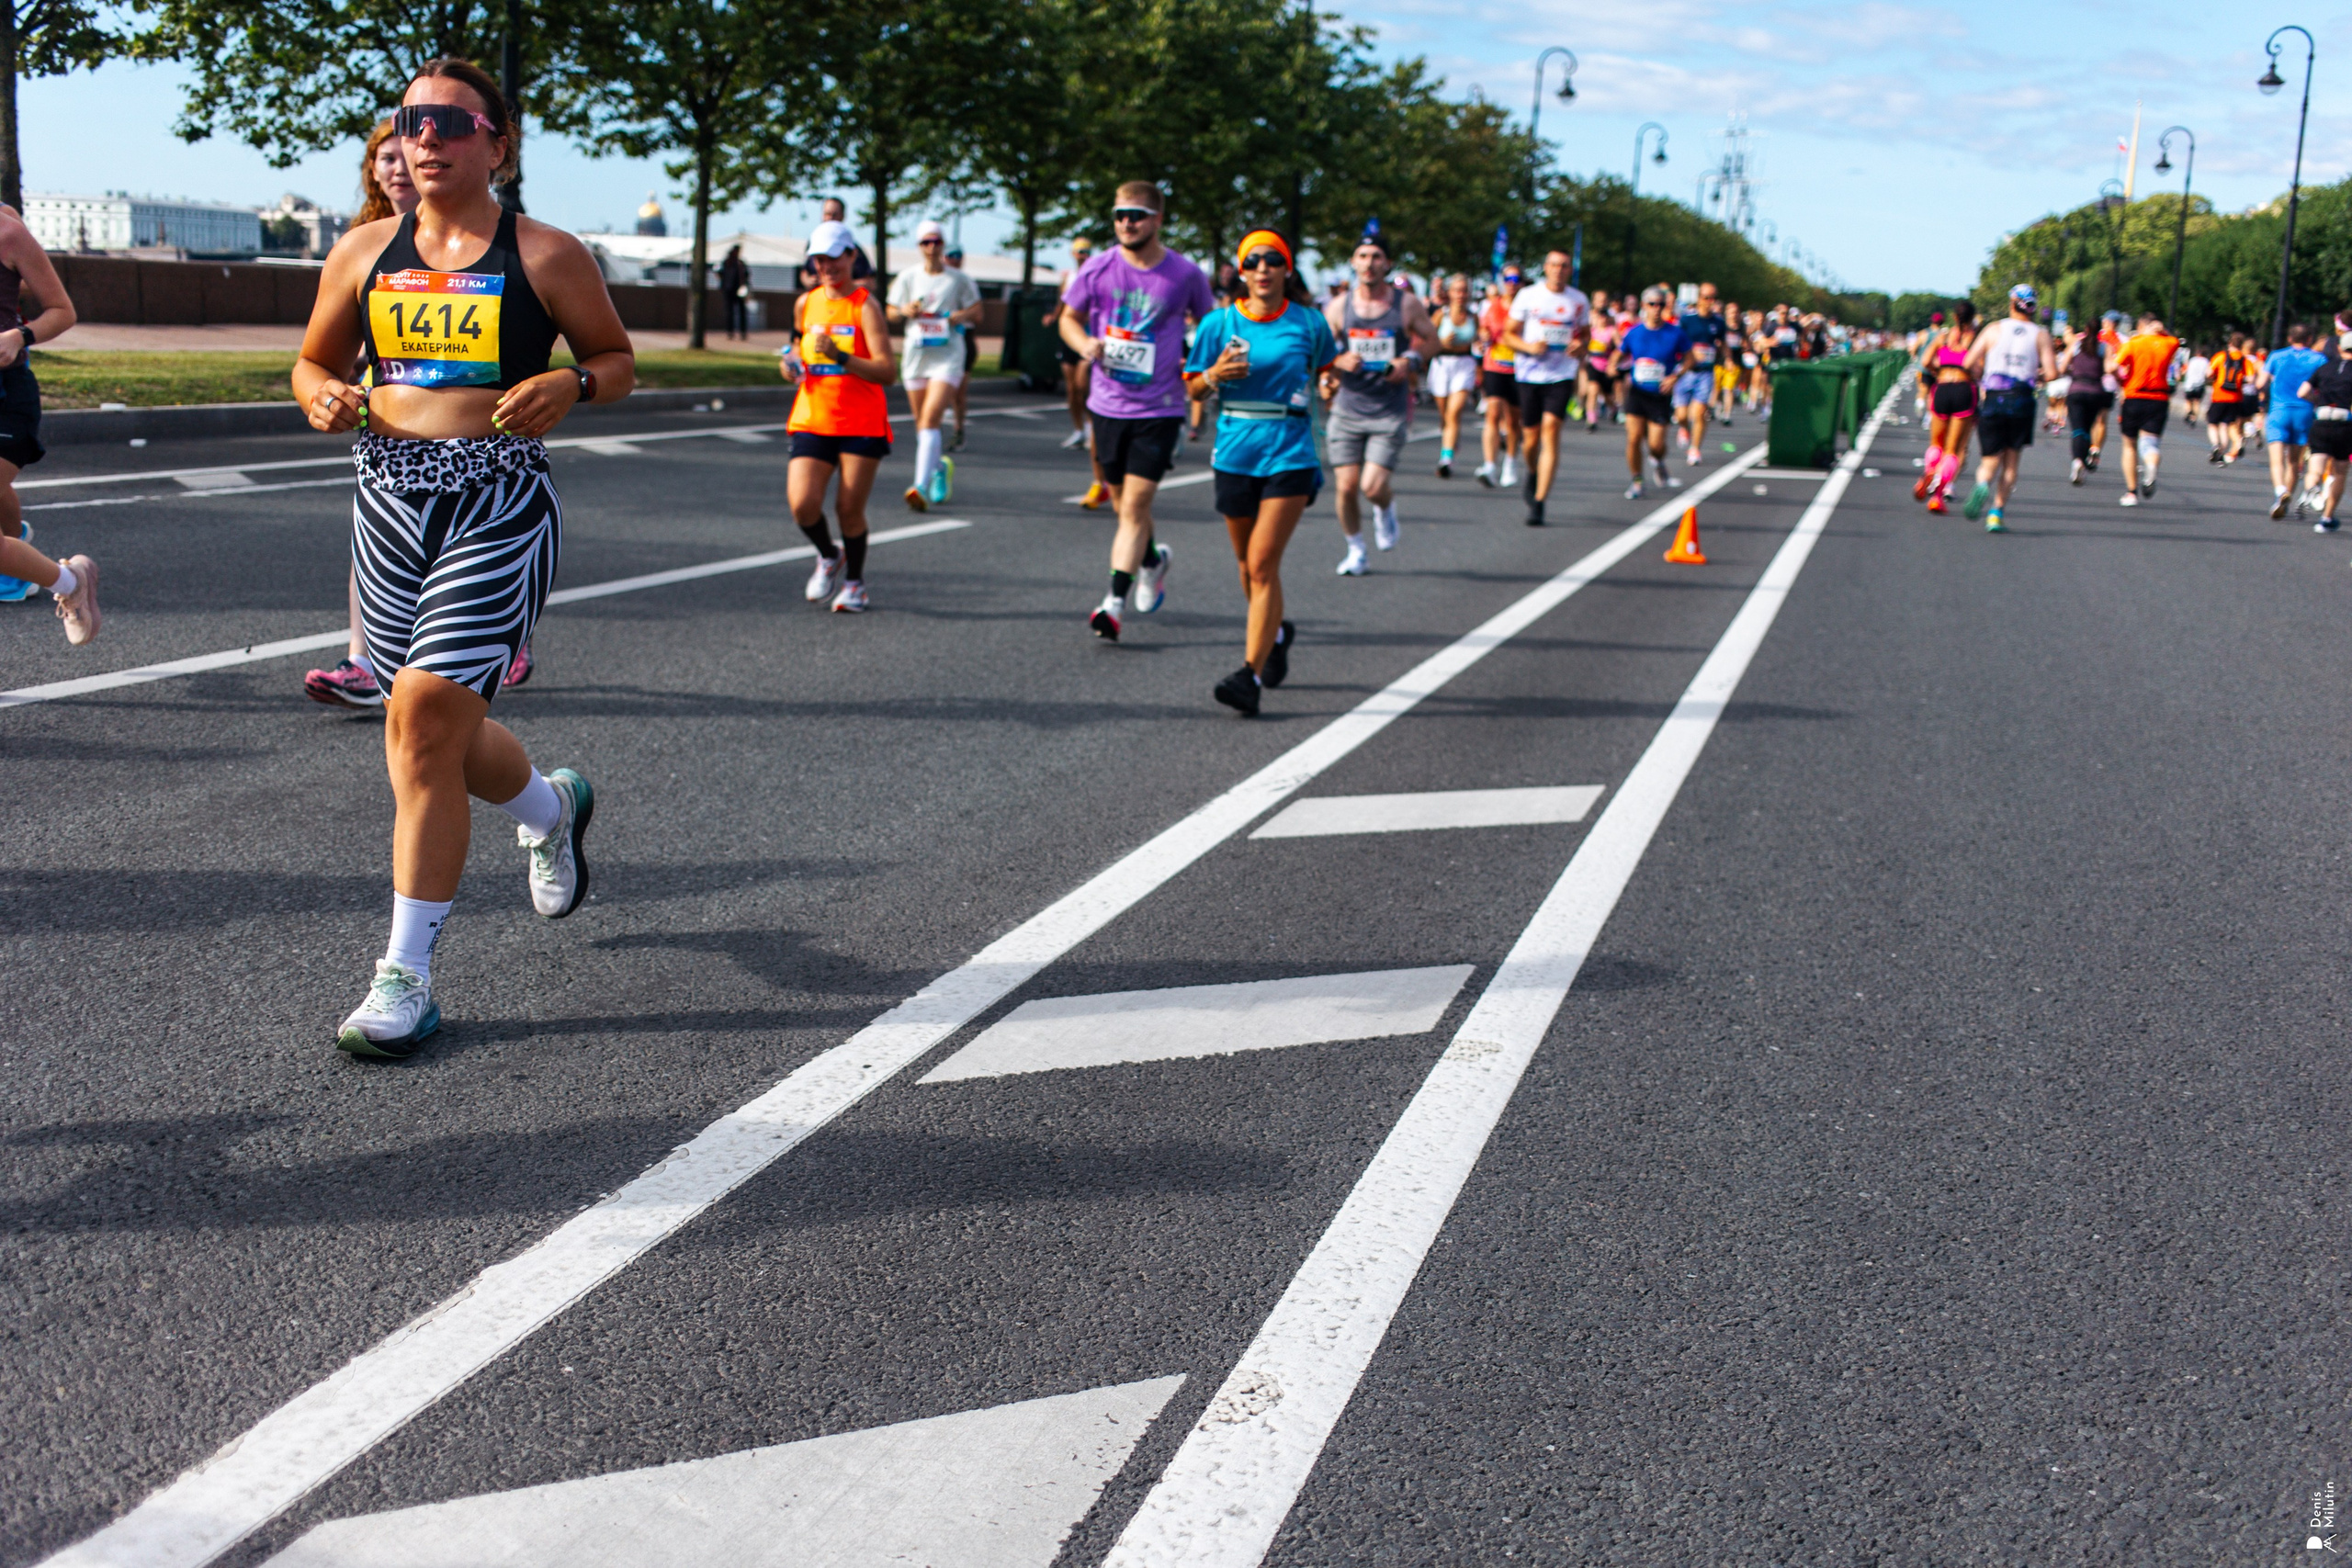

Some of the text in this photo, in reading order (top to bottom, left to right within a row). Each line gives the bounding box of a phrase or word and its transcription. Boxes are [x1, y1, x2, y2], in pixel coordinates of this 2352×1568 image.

[389, 277, 429, 286] МАРАФОН
[447, 278, 486, 288] 21,1 КМ
[390, 302, 481, 340] 1414
[401, 342, 469, 354] ЕКАТЕРИНА
